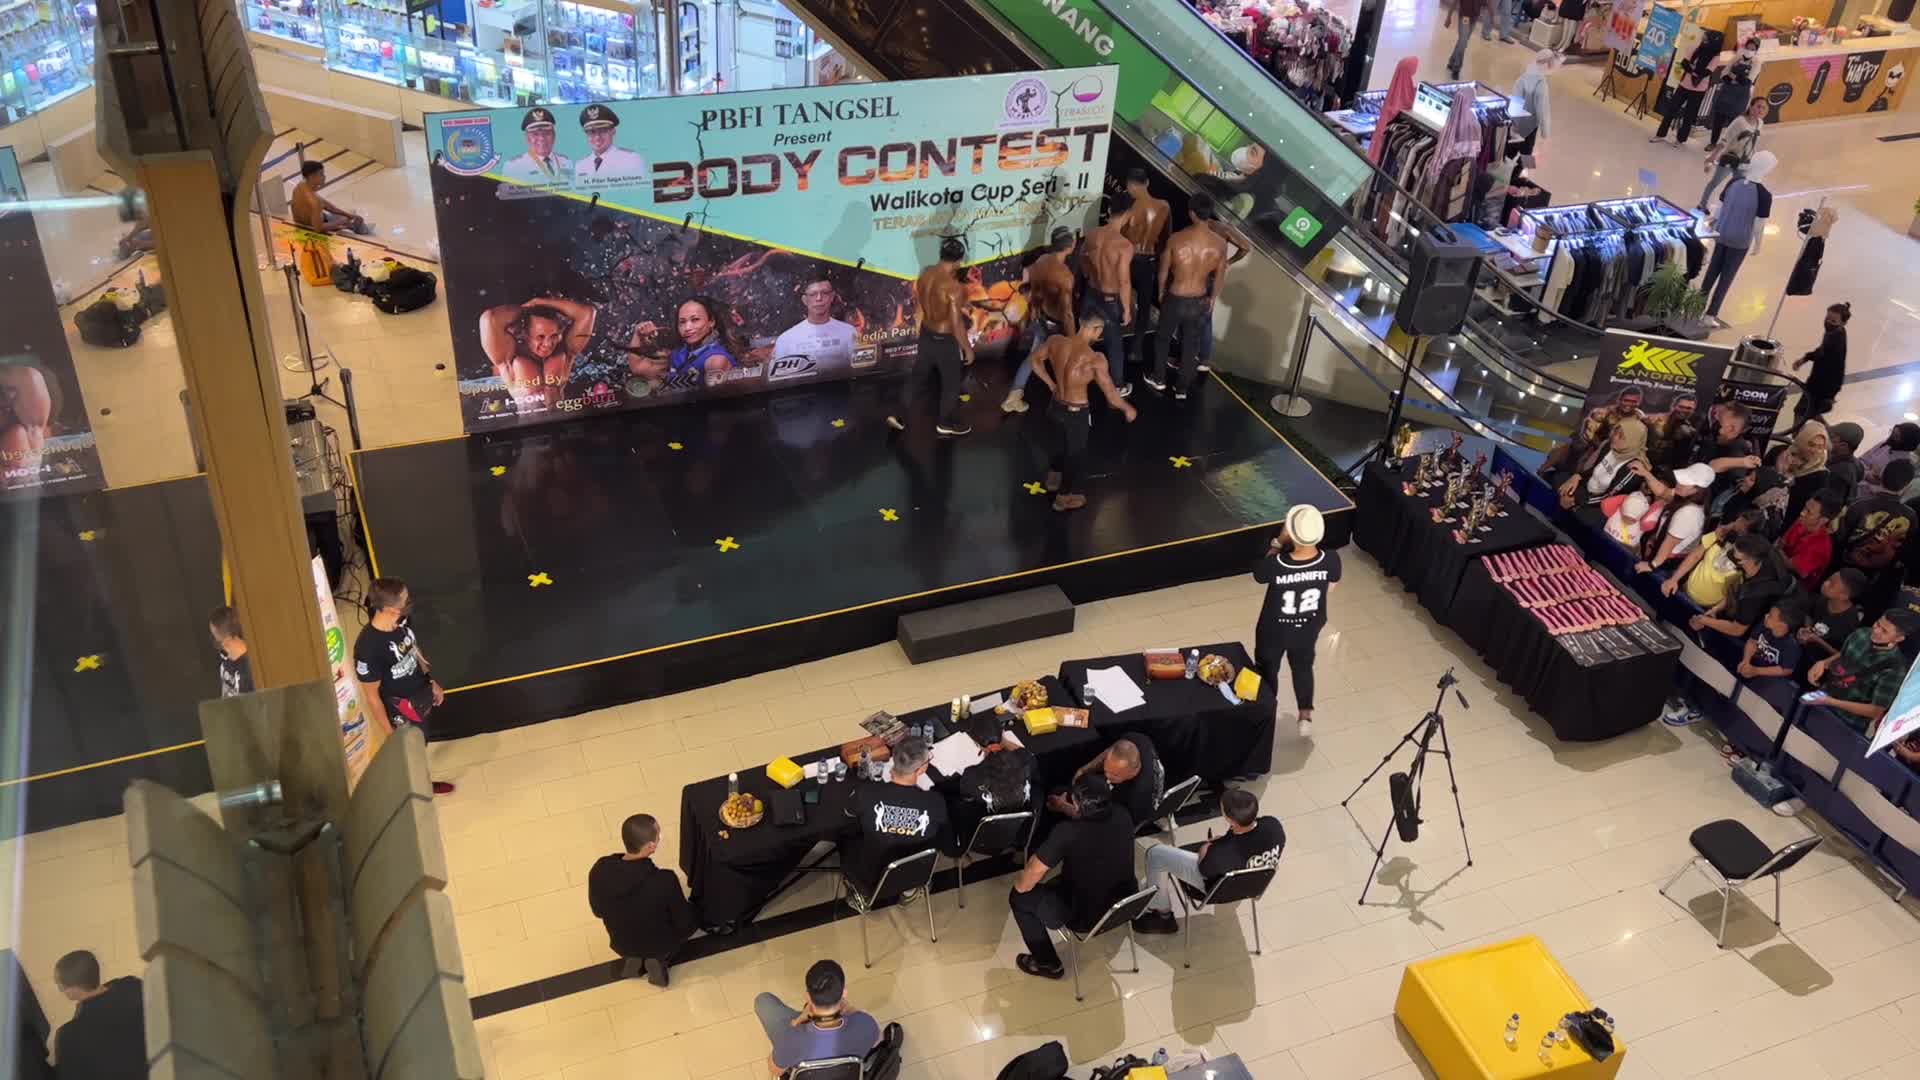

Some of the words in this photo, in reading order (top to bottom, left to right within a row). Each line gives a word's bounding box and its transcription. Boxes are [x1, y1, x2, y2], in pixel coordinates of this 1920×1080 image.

[702, 105, 762, 131] PBFI
[773, 96, 899, 125] TANGSEL
[773, 131, 832, 146] Present
[652, 149, 824, 203] BODY
[838, 124, 1109, 186] CONTEST
[870, 185, 963, 212] Walikota
[971, 181, 1013, 204] Cup
[1022, 175, 1057, 197] Seri
[1078, 173, 1089, 190] II
[891, 327, 917, 339] Part
[545, 375, 563, 387] By
[1735, 389, 1768, 400] I-CON
[1276, 570, 1329, 584] MAGNIFIT
[1281, 588, 1321, 615] 12
[1248, 845, 1280, 869] ICON
